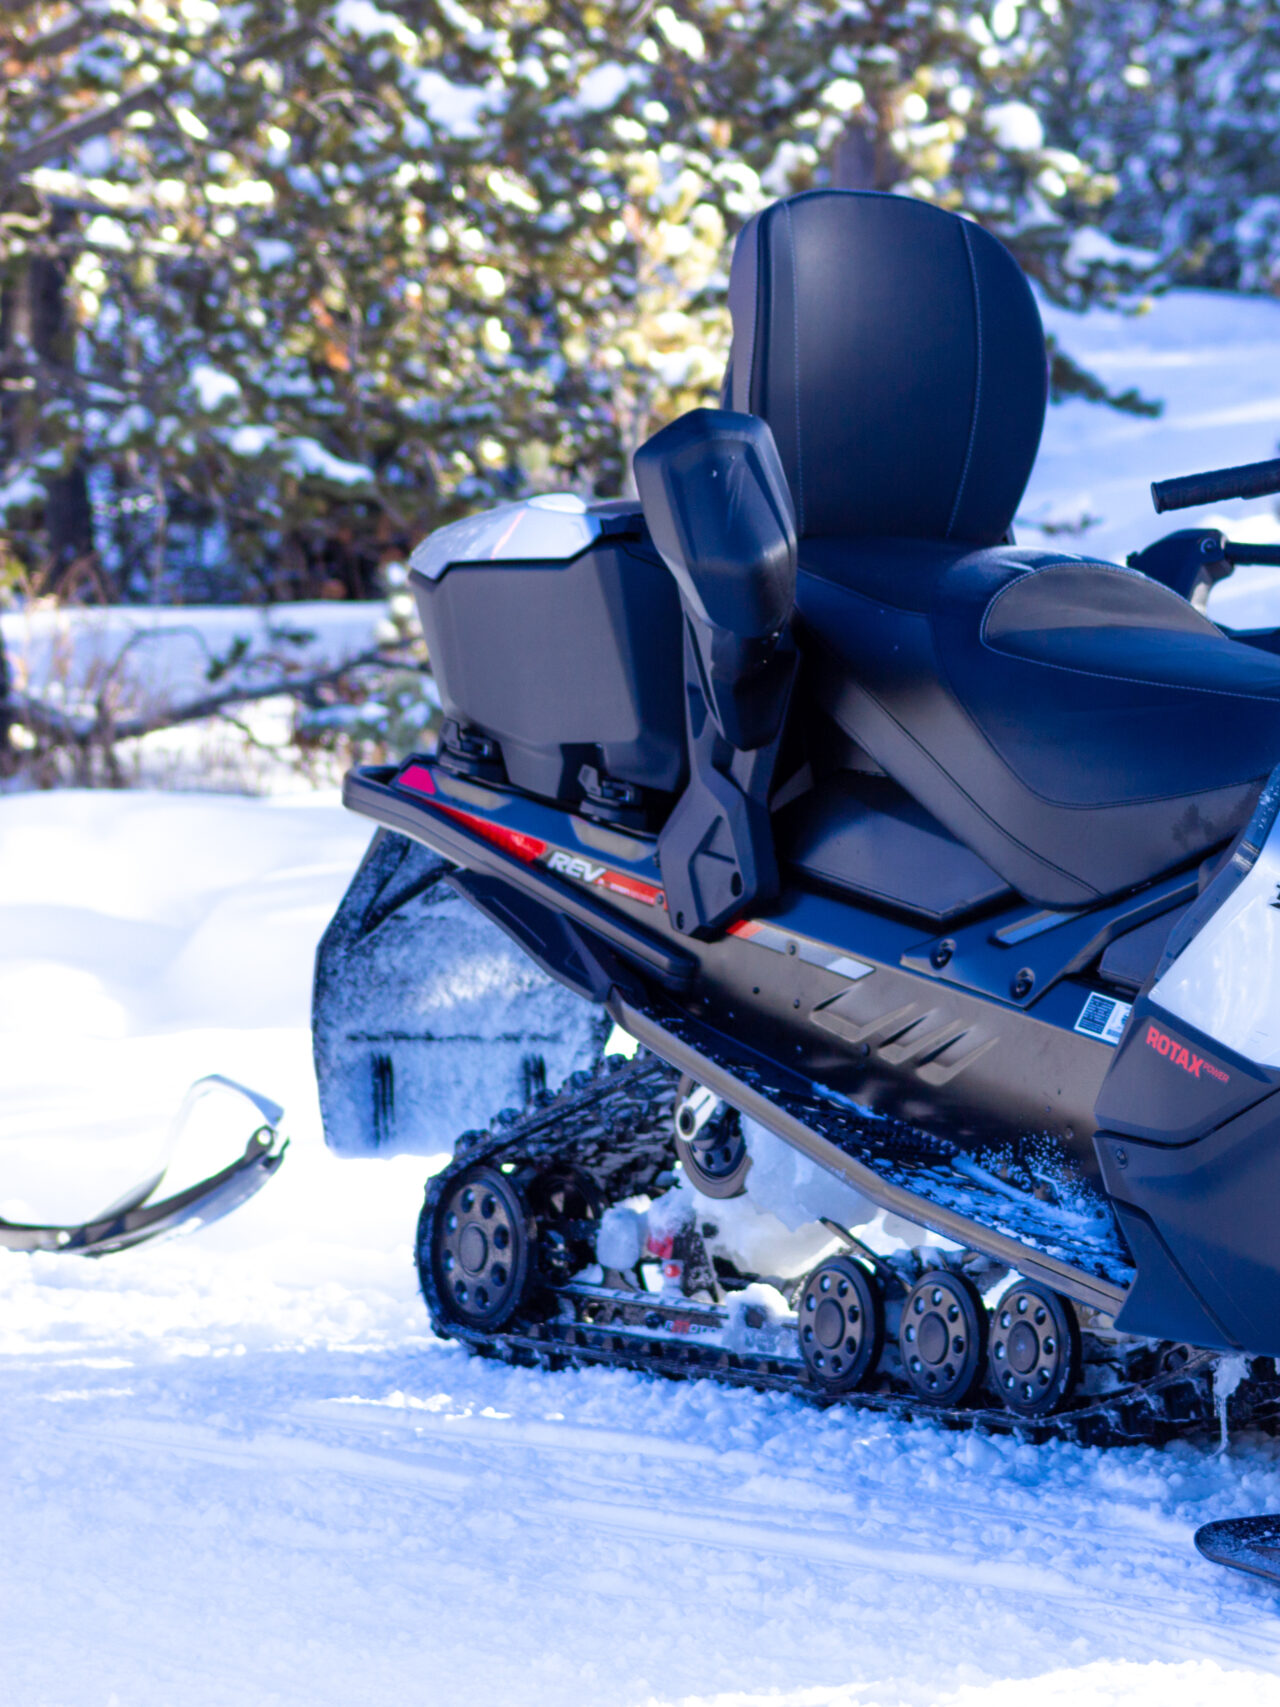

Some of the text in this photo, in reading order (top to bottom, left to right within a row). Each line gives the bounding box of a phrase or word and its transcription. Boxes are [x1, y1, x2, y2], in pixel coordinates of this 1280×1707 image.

[548, 851, 606, 882] REV
[1146, 1025, 1230, 1083] ROTAX POWER
